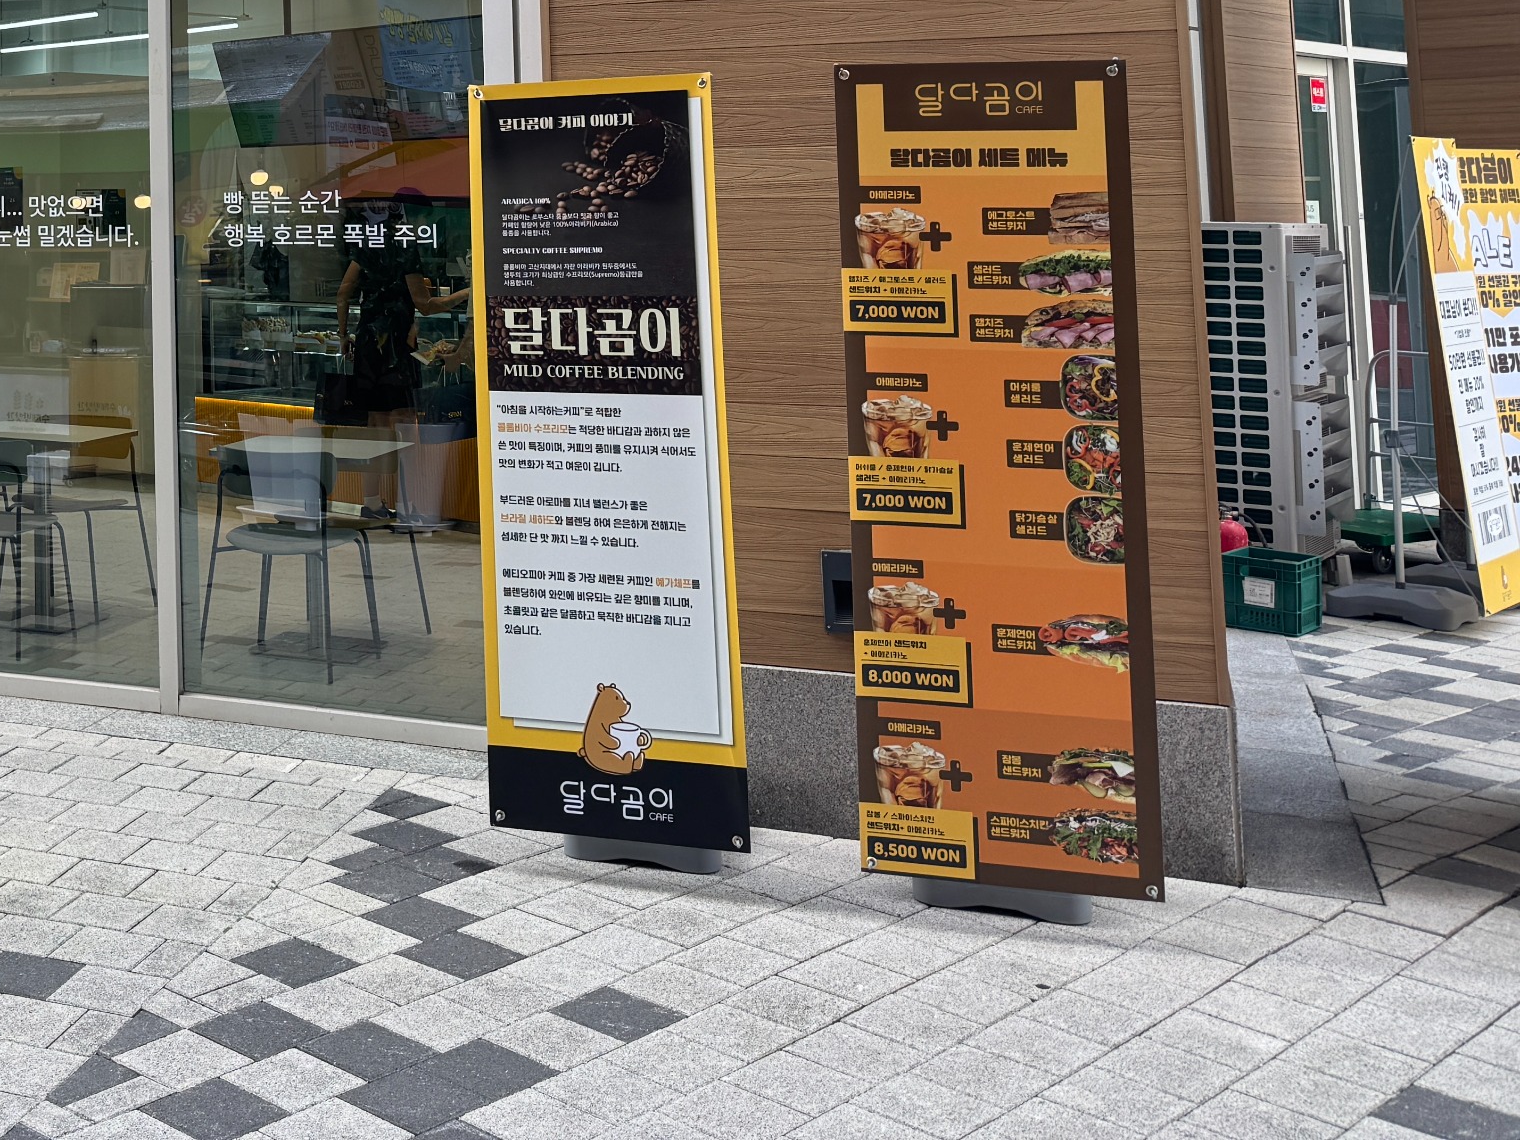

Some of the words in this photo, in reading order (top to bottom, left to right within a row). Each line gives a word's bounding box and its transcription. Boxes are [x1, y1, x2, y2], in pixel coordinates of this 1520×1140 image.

[914, 80, 1043, 117] 달다곰이
[1015, 105, 1044, 114] CAFE
[498, 116, 554, 132] 달다곰이
[557, 114, 586, 129] 커피
[589, 112, 633, 128] 이야기
[890, 148, 972, 168] 달다곰이
[978, 147, 1020, 167] 세트
[1026, 147, 1068, 167] 메뉴
[223, 190, 244, 214] 빵
[298, 189, 342, 214] 순간
[869, 190, 915, 199] 아메리카노
[29, 194, 104, 218] 맛없으면
[987, 221, 1026, 231] 샌드위치
[37, 224, 140, 248] 밀겠습니다.
[224, 223, 266, 248] 행복
[272, 223, 337, 248] 호르몬
[343, 223, 387, 248] 폭발
[393, 223, 438, 249] 주의
[1471, 227, 1514, 268] ALE
[973, 264, 1002, 275] 샐러드
[973, 275, 1012, 285] 샌드위치
[1479, 290, 1501, 308] 0%
[855, 305, 898, 319] 7,000
[901, 306, 939, 319] WON
[502, 306, 682, 357] 달다곰이
[975, 328, 1014, 339] 샌드위치
[503, 364, 543, 378] MILD
[546, 364, 603, 380] COFFEE
[608, 365, 685, 381] BLENDING
[875, 377, 923, 388] 아메리카노
[1010, 382, 1041, 393] 머쉬룸
[534, 424, 577, 435] 수프리모는
[579, 425, 605, 435] 적당한
[607, 426, 642, 437] 바디감과
[644, 427, 671, 438] 과하지
[673, 427, 691, 439] 않은
[498, 441, 507, 450] 쓴
[508, 440, 526, 451] 맛이
[528, 442, 565, 453] 특징이며,
[567, 443, 593, 453] 커피의
[595, 444, 621, 455] 풍미를
[623, 445, 659, 456] 유지시켜
[661, 446, 697, 457] 식어서도
[1012, 442, 1055, 453] 훈제연어
[498, 458, 516, 469] 맛의
[518, 459, 545, 470] 변화가
[546, 460, 563, 470] 적고
[565, 461, 591, 472] 여운이
[593, 462, 623, 473] 깁니다.
[500, 494, 535, 506] 부드러운
[536, 496, 571, 508] 아로마를
[573, 498, 591, 508] 지녀
[593, 498, 629, 510] 밸런스가
[862, 493, 905, 508] 7,000
[908, 495, 947, 510] WON
[500, 512, 527, 524] 브라질
[565, 516, 592, 527] 블렌딩
[593, 517, 611, 529] 하여
[613, 518, 649, 530] 은은하게
[651, 520, 687, 532] 전해지는
[1015, 512, 1058, 525] 닭가슴살
[501, 531, 527, 542] 섬세한
[529, 532, 538, 542] 단
[540, 533, 550, 543] 맛
[551, 534, 569, 544] 까지
[570, 535, 588, 546] 느낄
[590, 535, 599, 546] 수
[601, 536, 639, 548] 있습니다.
[872, 562, 919, 574] 아메리카노
[502, 568, 546, 580] 에티오피아
[548, 570, 565, 581] 커피
[567, 571, 576, 582] 중
[578, 572, 596, 584] 가장
[598, 574, 624, 586] 세련된
[626, 575, 653, 587] 커피인
[503, 586, 547, 599] 블렌딩하여
[548, 589, 575, 601] 와인에
[577, 591, 612, 603] 비유되는
[614, 593, 632, 605] 깊은
[634, 594, 661, 607] 향미를
[663, 596, 693, 609] 지니며,
[503, 605, 539, 617] 초콜릿과
[540, 607, 558, 619] 같은
[560, 608, 595, 621] 달콤하고
[597, 611, 624, 623] 묵직한
[626, 613, 662, 626] 바디감을
[663, 615, 691, 627] 지니고
[504, 623, 542, 636] 있습니다.
[996, 627, 1036, 640] 훈제연어
[996, 638, 1037, 651] 샌드위치
[868, 669, 912, 684] 8,000
[915, 671, 954, 688] WON
[887, 722, 936, 735] 아메리카노
[1002, 765, 1042, 778] 샌드위치
[559, 780, 673, 821] 달다곰이
[648, 811, 674, 823] CAFE
[873, 842, 918, 859] 8,500
[921, 846, 960, 863] WON
